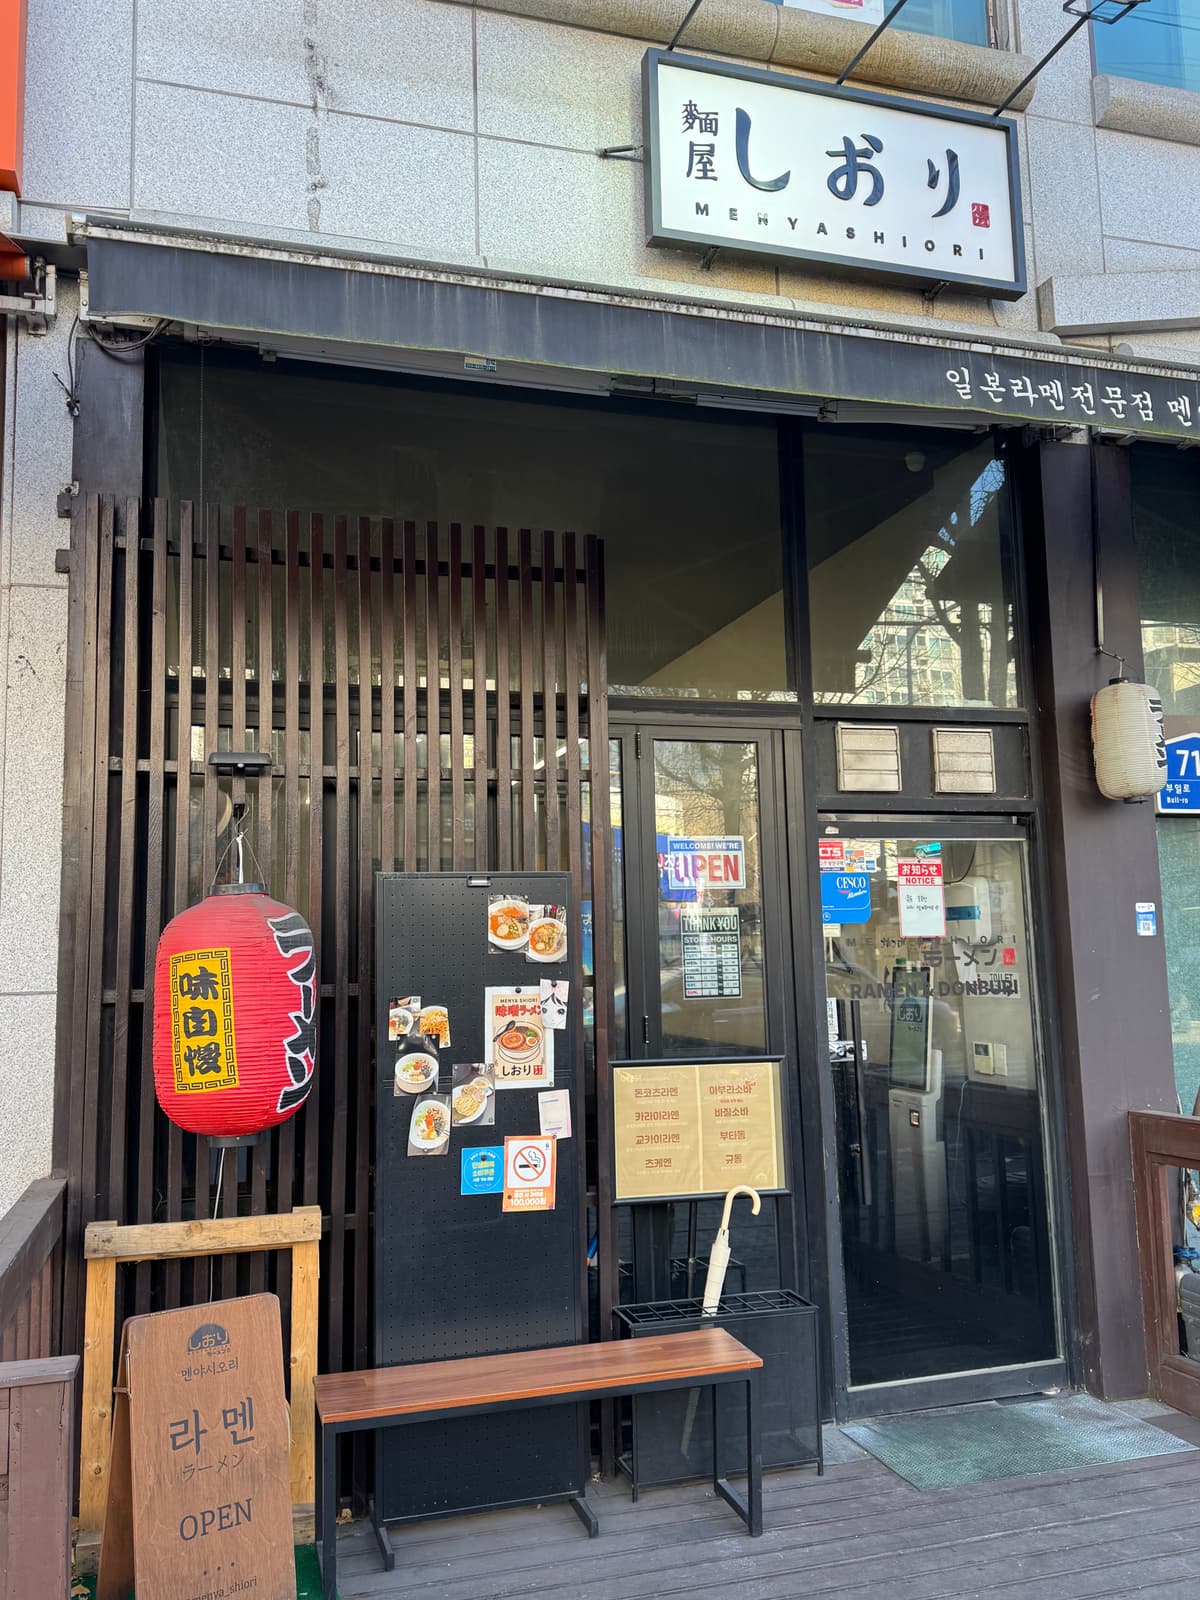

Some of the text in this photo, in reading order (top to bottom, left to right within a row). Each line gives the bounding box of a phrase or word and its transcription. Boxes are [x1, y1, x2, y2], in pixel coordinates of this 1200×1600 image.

[735, 107, 960, 218] しおり
[1167, 395, 1200, 427] 멘
[1166, 784, 1191, 795] 부일로
[673, 842, 714, 850] WELCOME!
[674, 854, 739, 883] OPEN
[902, 864, 938, 875] お知らせ
[836, 876, 866, 889] CESCO
[683, 916, 737, 931] THANK YOU
[922, 948, 997, 967] ラーメン
[989, 973, 1013, 982] TOILET
[851, 982, 919, 1000] RAMEN
[938, 979, 1018, 996] DONBURI
[502, 1064, 531, 1076] しおり
[634, 1087, 679, 1098] 돈코츠라멘
[634, 1110, 680, 1121] 카라이라멘
[714, 1106, 749, 1117] 바질소바
[635, 1133, 681, 1145] 교카이라멘
[720, 1130, 746, 1141] 부타동
[645, 1158, 672, 1169] 츠케멘
[725, 1154, 743, 1165] 규동
[189, 1331, 228, 1350] しおり
[181, 1356, 239, 1382] 멘야시오리
[182, 1453, 245, 1482] ラーメン
[179, 1498, 253, 1541] OPEN
